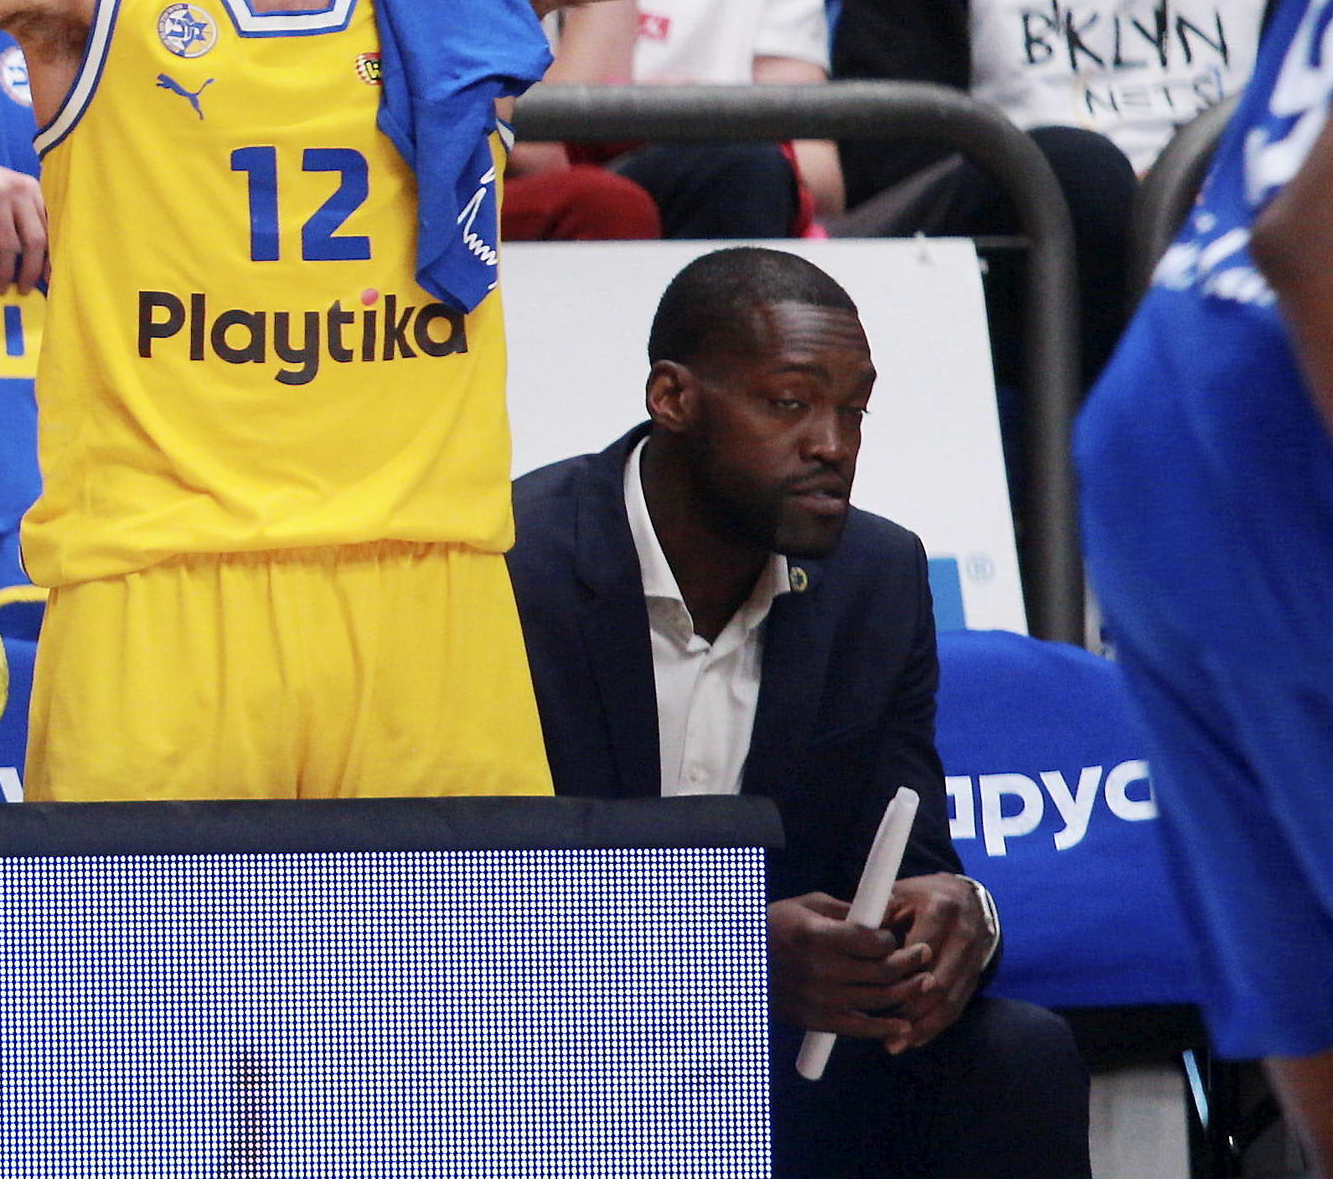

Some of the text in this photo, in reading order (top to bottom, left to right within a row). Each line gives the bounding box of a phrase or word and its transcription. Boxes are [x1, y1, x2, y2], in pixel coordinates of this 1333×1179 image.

[1021, 8, 1229, 71] BKLYN
[231, 146, 372, 261] 12
[138, 287, 469, 386] Playtika
